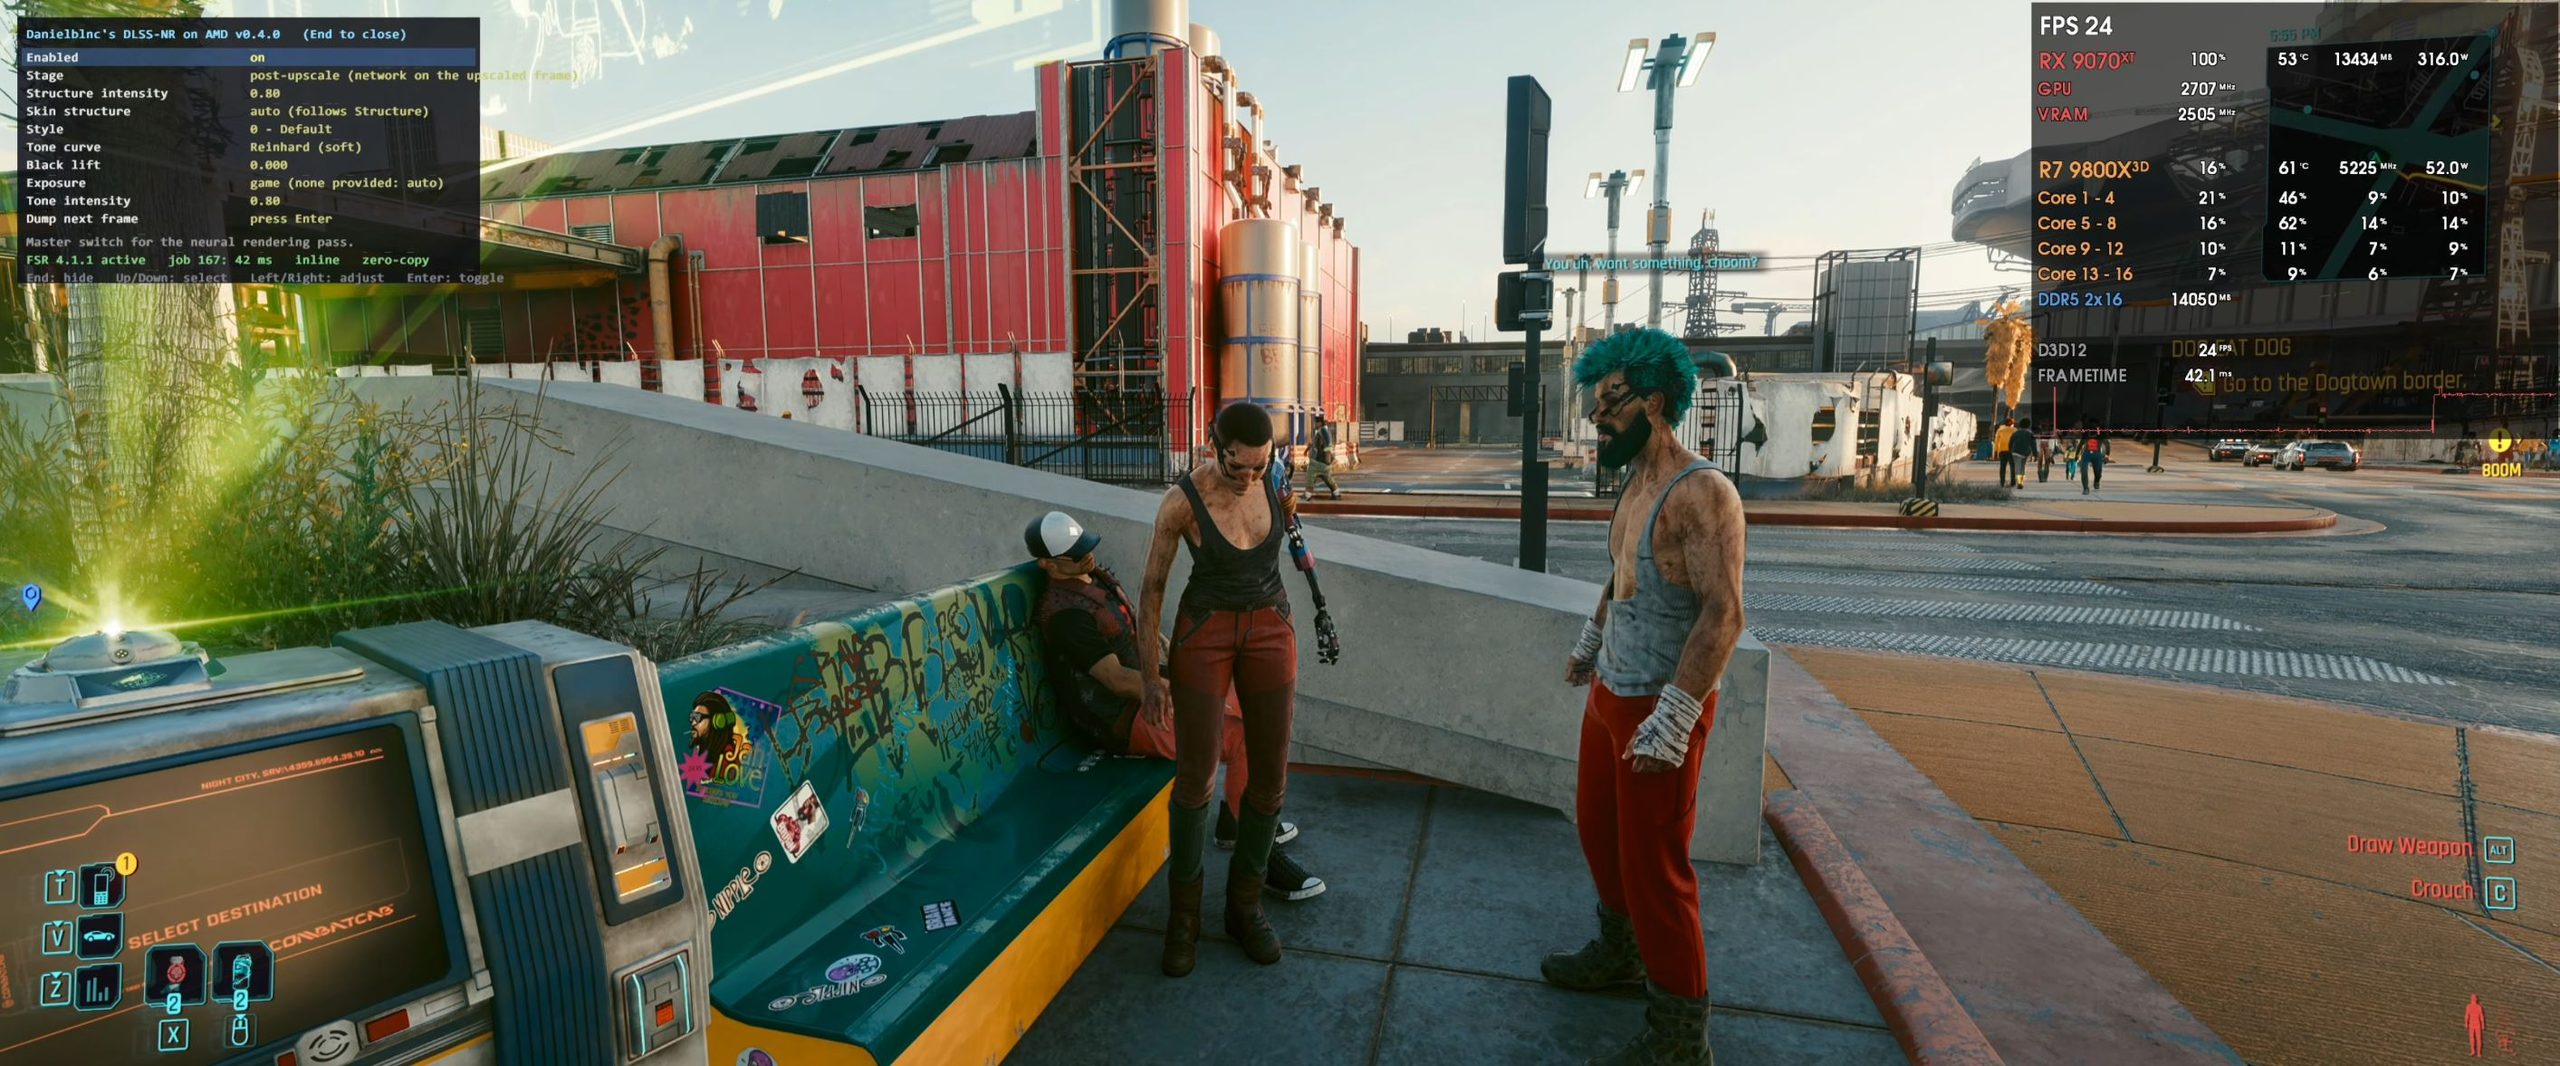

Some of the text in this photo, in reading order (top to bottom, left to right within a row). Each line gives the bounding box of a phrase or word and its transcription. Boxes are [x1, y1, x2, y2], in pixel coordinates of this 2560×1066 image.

[726, 732, 766, 769] Jah
[201, 776, 233, 790] NIGHT
[128, 884, 322, 950] SELECT DESTINATION
